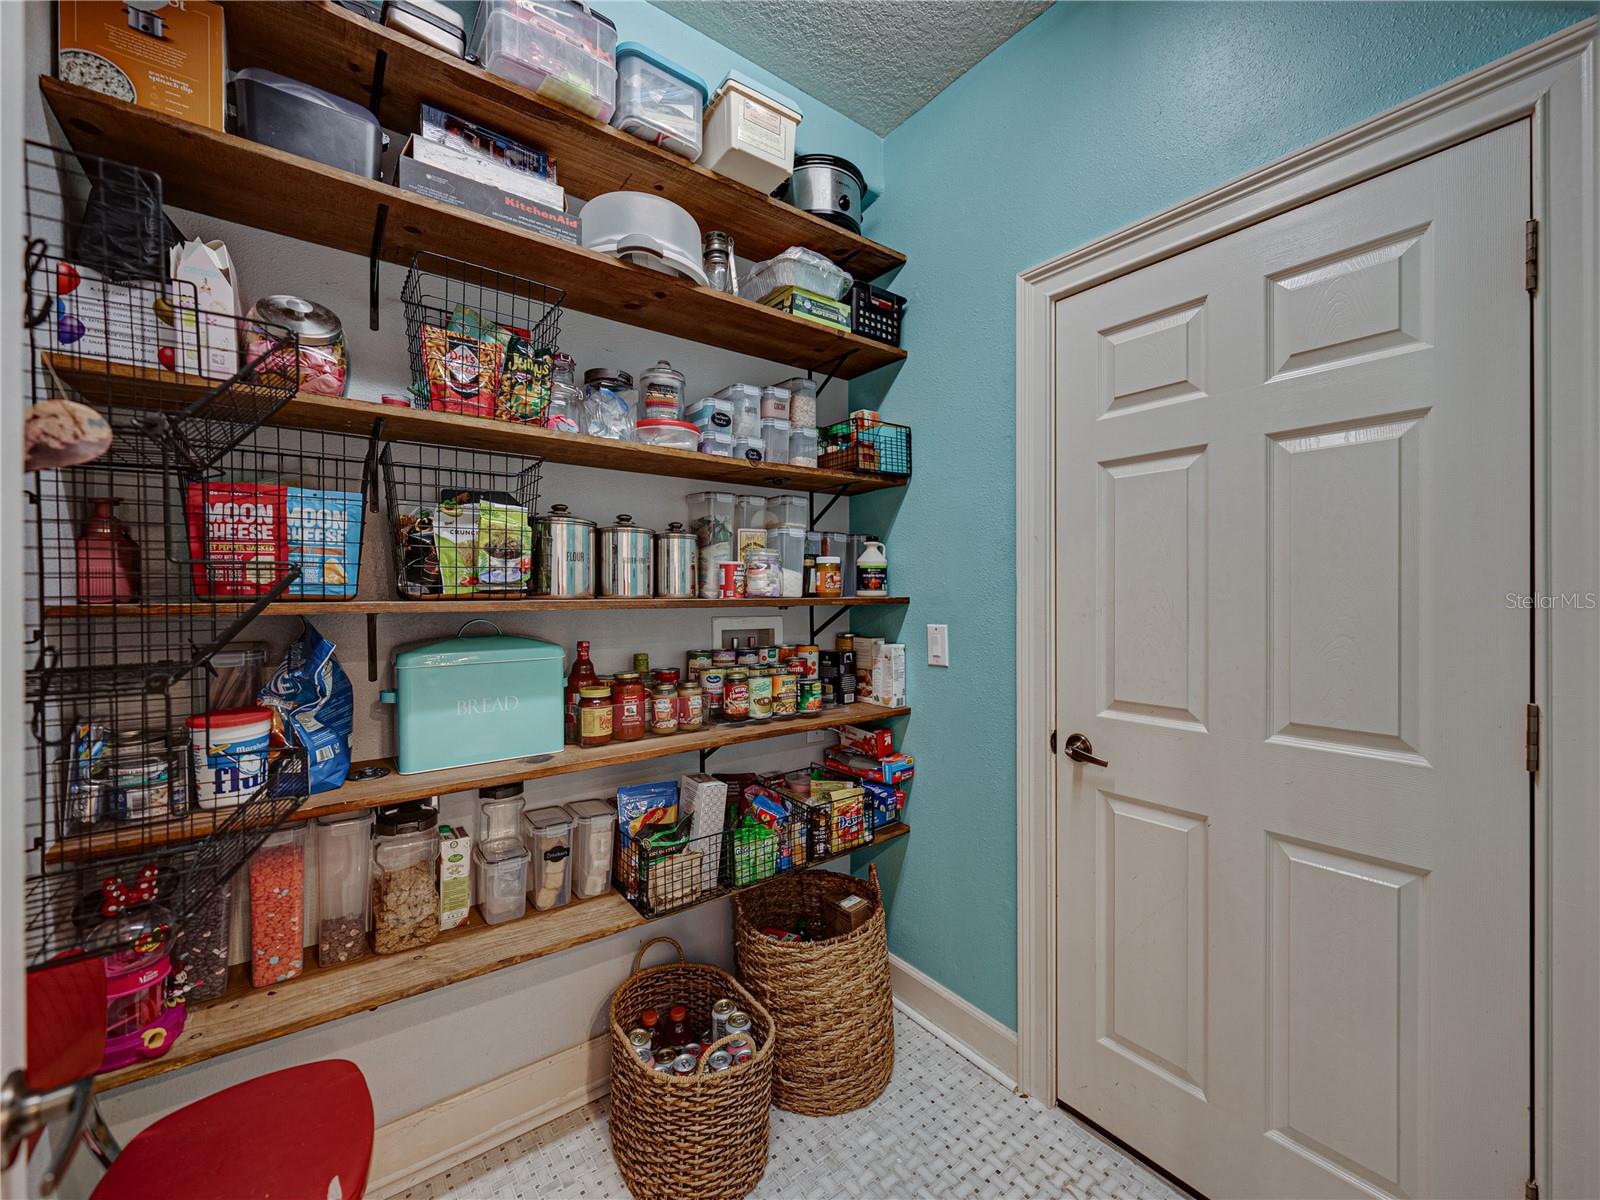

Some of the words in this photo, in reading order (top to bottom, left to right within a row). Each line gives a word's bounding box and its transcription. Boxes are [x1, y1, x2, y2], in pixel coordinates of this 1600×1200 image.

[148, 74, 179, 89] spinach
[179, 83, 194, 95] dip
[504, 196, 578, 228] KitchenAid
[206, 502, 274, 525] MOON
[287, 507, 348, 530] MOON
[566, 551, 585, 562] FLOUR
[456, 695, 519, 716] BREAD
